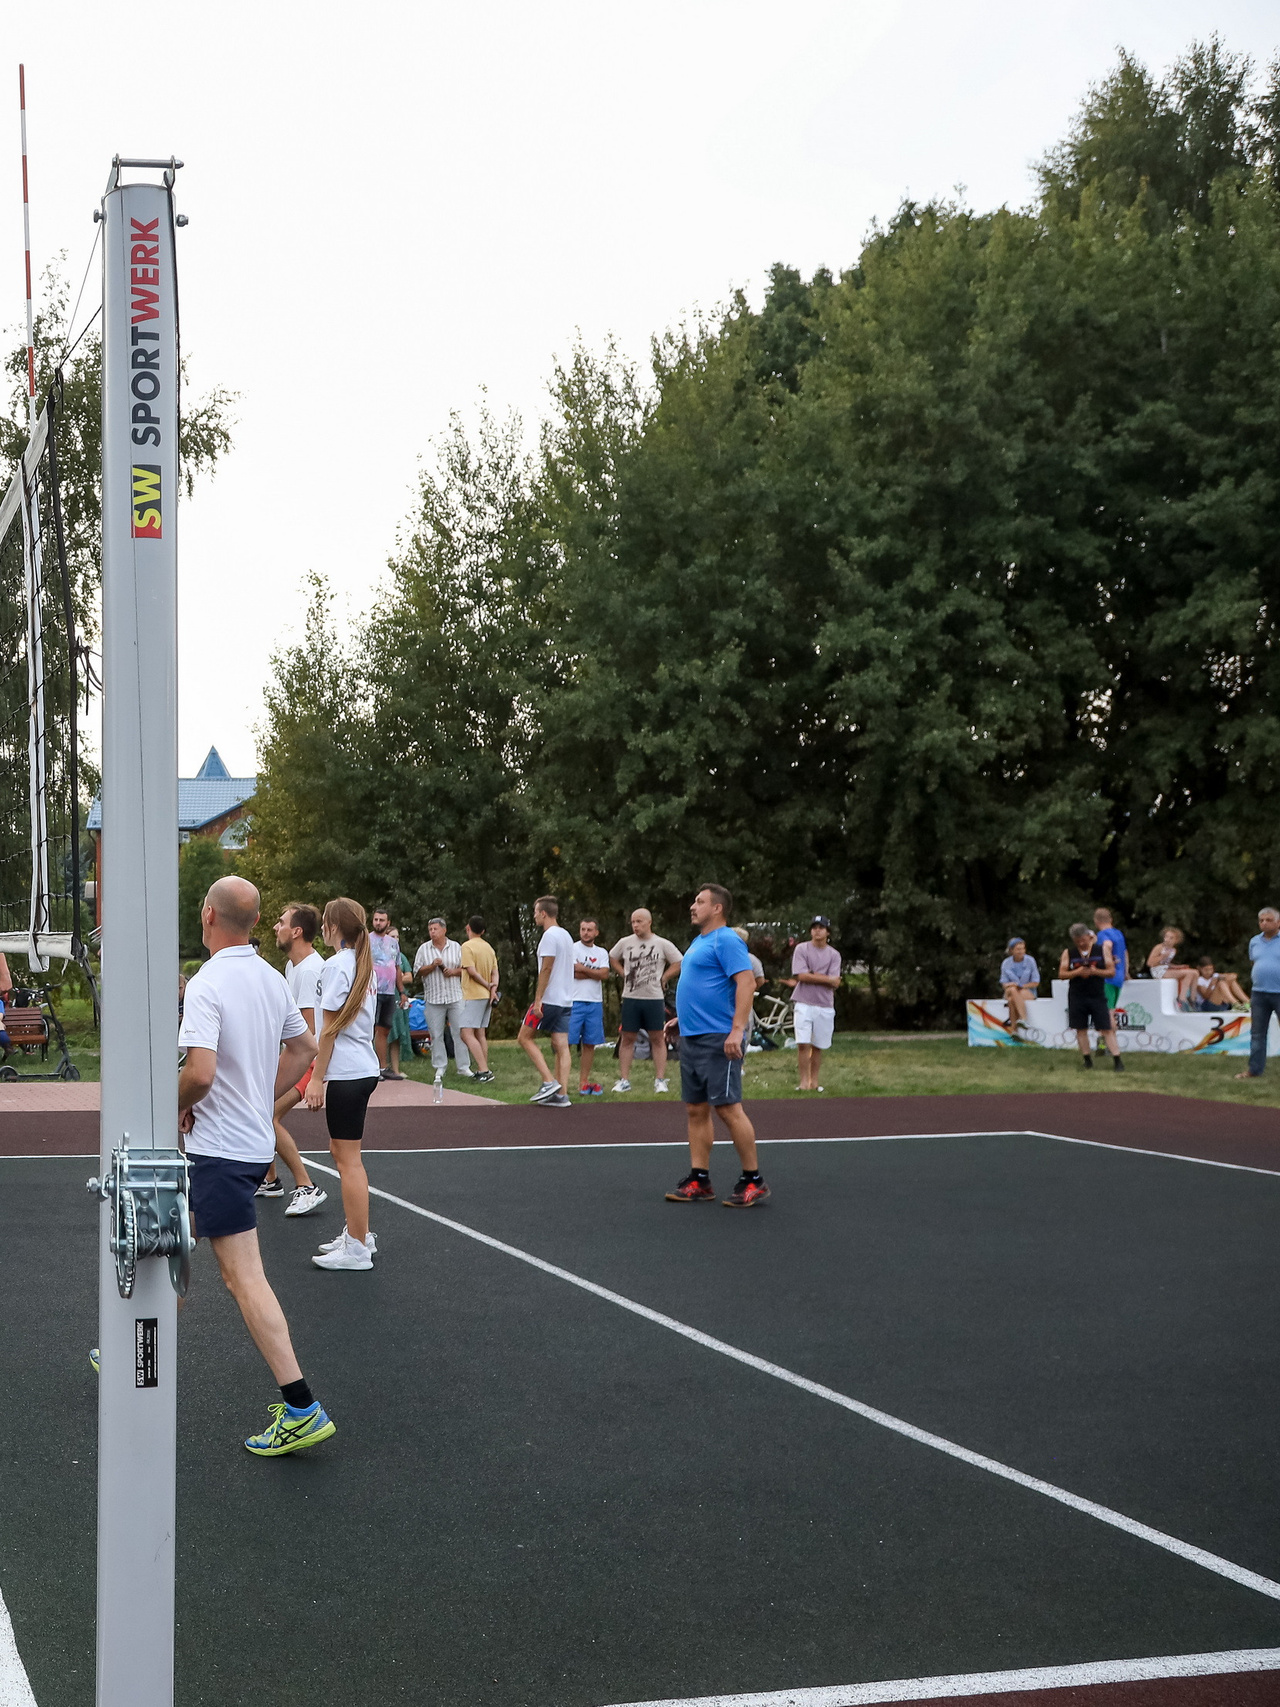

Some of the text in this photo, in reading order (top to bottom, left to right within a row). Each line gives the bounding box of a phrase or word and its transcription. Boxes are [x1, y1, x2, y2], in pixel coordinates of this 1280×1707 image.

[131, 217, 162, 530] SW SPORTWERK
[1209, 1017, 1225, 1045] 3
[137, 1370, 144, 1385] SW
